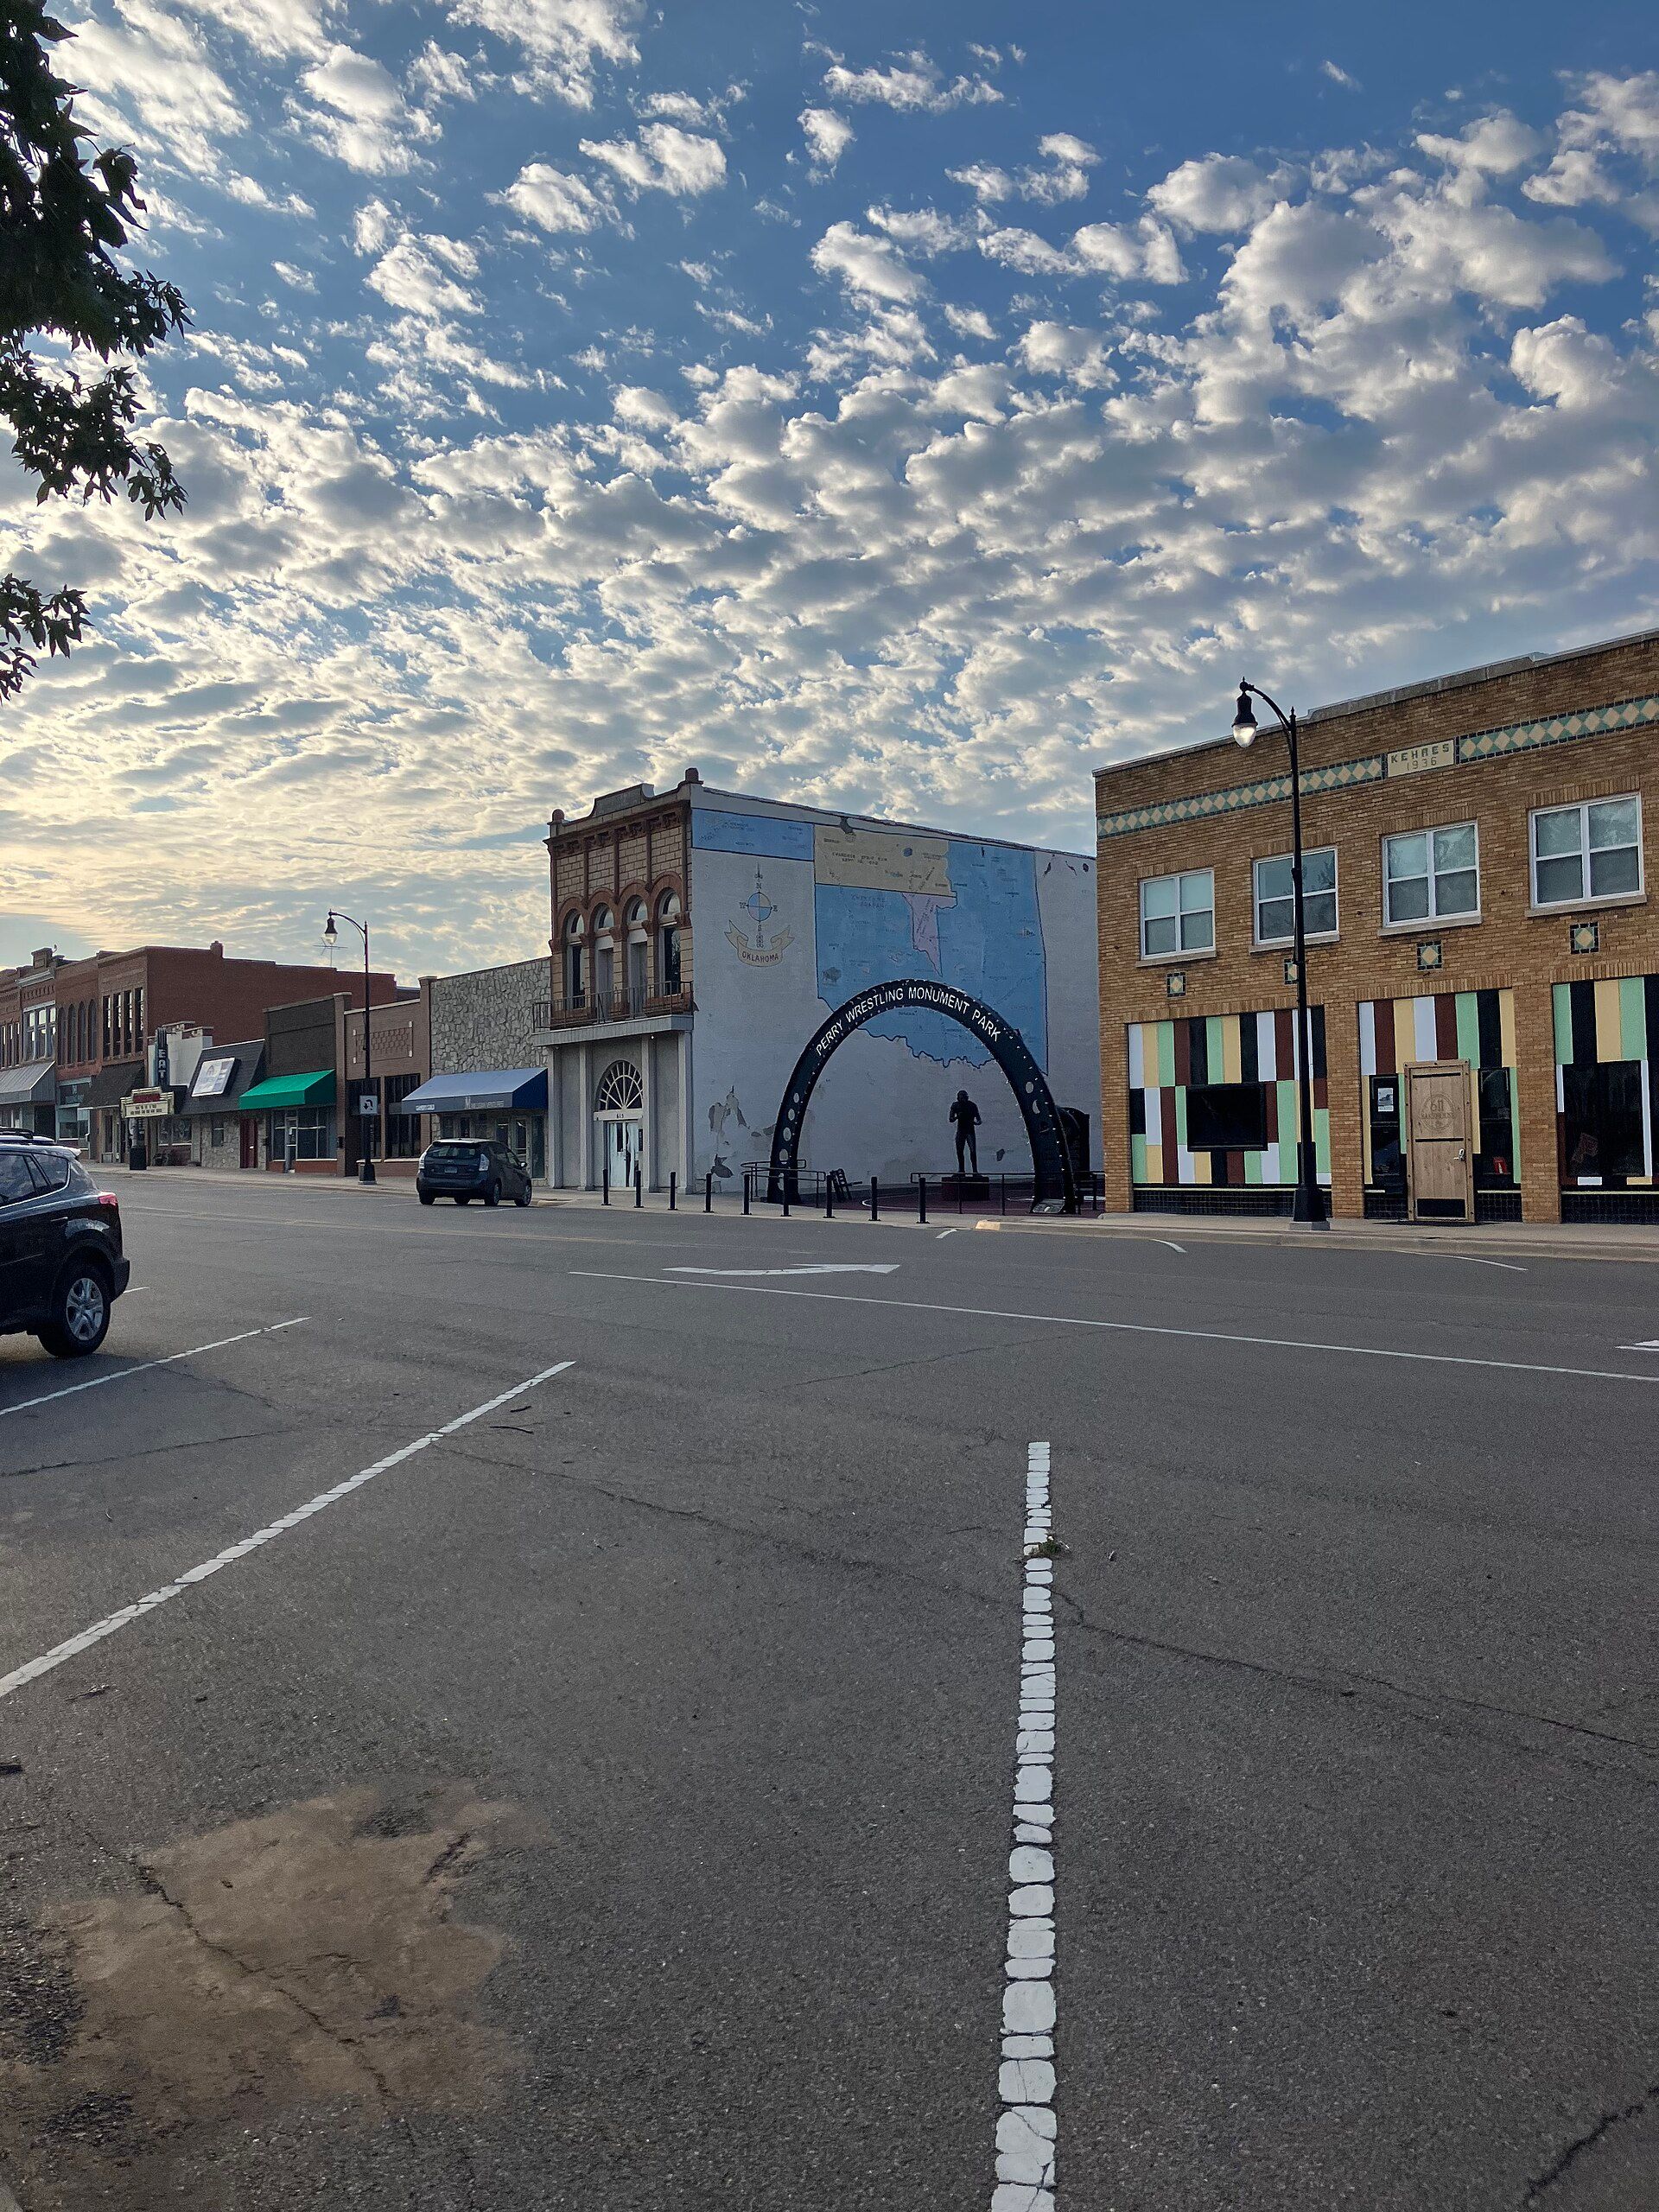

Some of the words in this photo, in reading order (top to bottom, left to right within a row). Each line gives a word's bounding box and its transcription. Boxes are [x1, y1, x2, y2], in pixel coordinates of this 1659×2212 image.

[1407, 756, 1437, 771] 1936
[741, 951, 779, 962] OKLAHOMA
[816, 1019, 844, 1056] PERRY
[845, 988, 904, 1023] WRESTLING
[908, 987, 970, 1014] MONUMENT
[971, 1008, 1001, 1042] PARK
